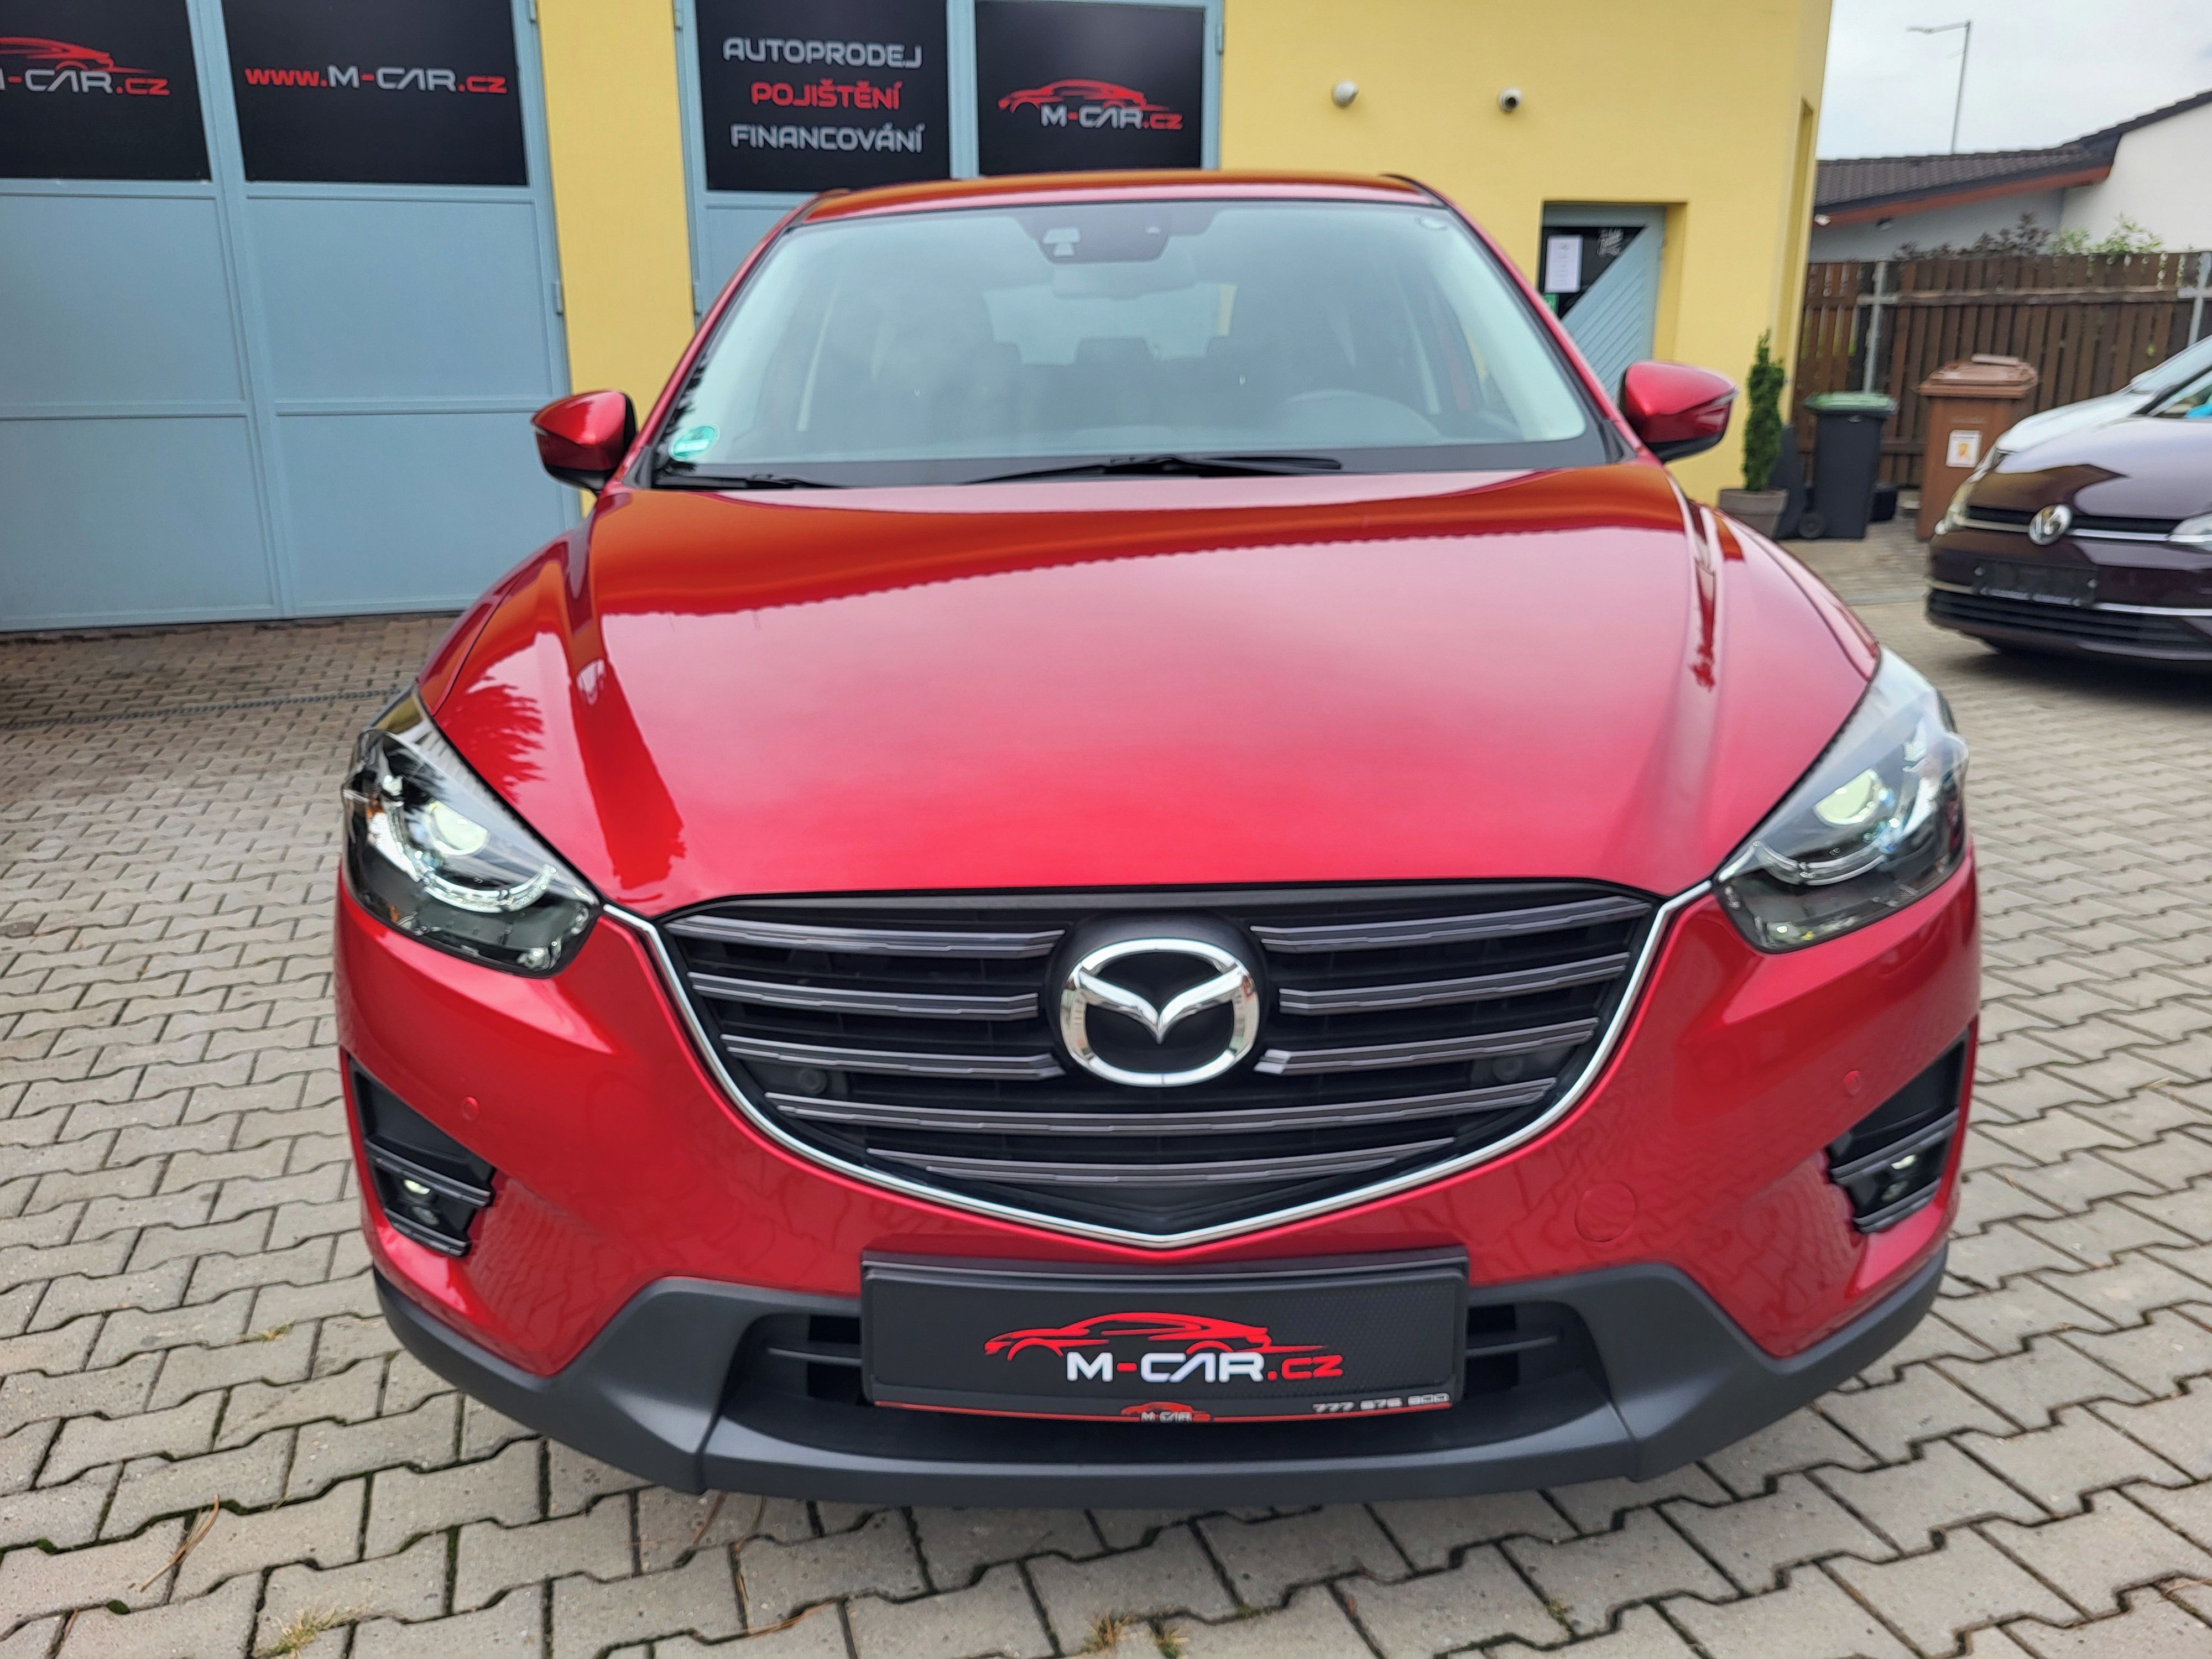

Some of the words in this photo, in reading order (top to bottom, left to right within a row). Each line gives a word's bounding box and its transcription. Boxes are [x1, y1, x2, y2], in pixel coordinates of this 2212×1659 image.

[723, 36, 922, 69] AUTOPRODEJ
[0, 67, 170, 96] -CAR.cz
[244, 65, 508, 94] www.M-CAR.cz
[750, 77, 902, 109] POJIŠTĚNÍ
[1040, 104, 1183, 130] M-CAR.cz
[730, 122, 926, 153] FINANCOVÁNÍ
[1067, 1352, 1343, 1383] M-CAR.cz
[1312, 1401, 1355, 1413] 777
